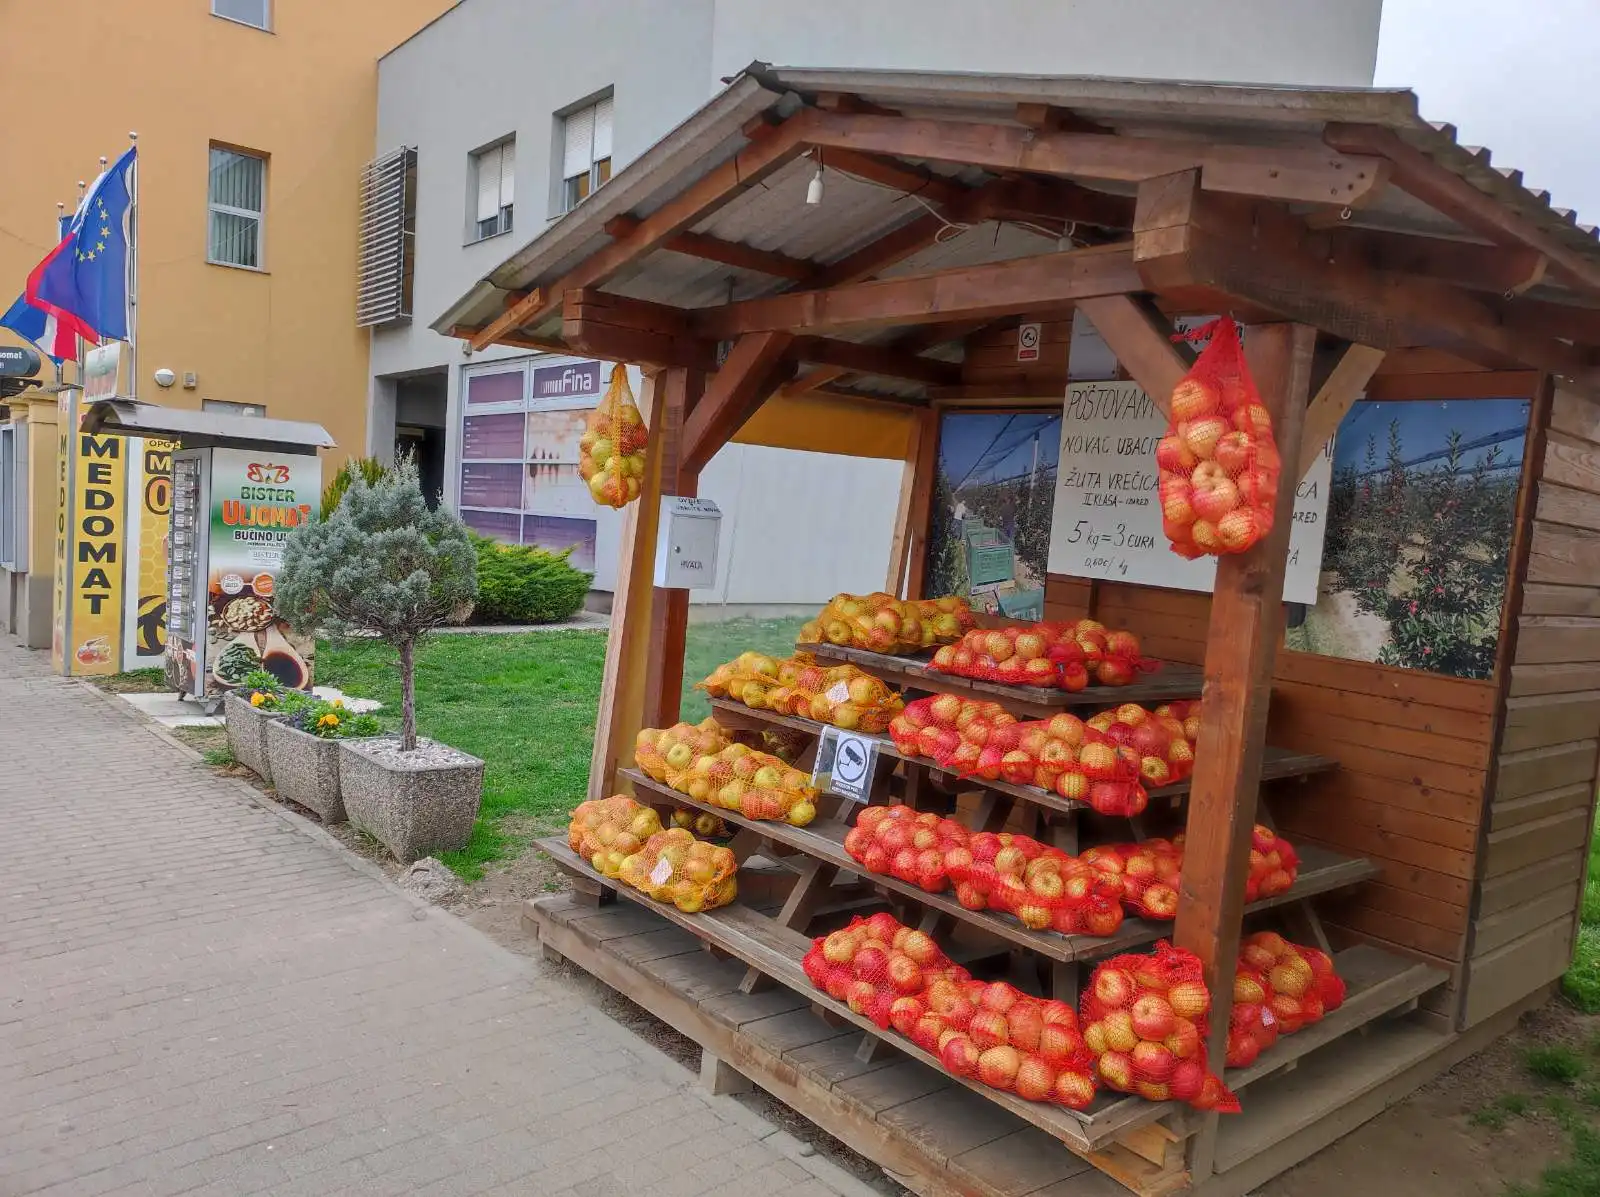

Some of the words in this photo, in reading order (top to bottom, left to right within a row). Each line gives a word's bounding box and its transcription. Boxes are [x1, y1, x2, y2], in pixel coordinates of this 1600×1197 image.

[1064, 466, 1101, 489] ŽUTA
[240, 486, 296, 503] BISTER
[78, 435, 120, 615] MEDOMAT
[222, 500, 312, 529] ULJOMAT
